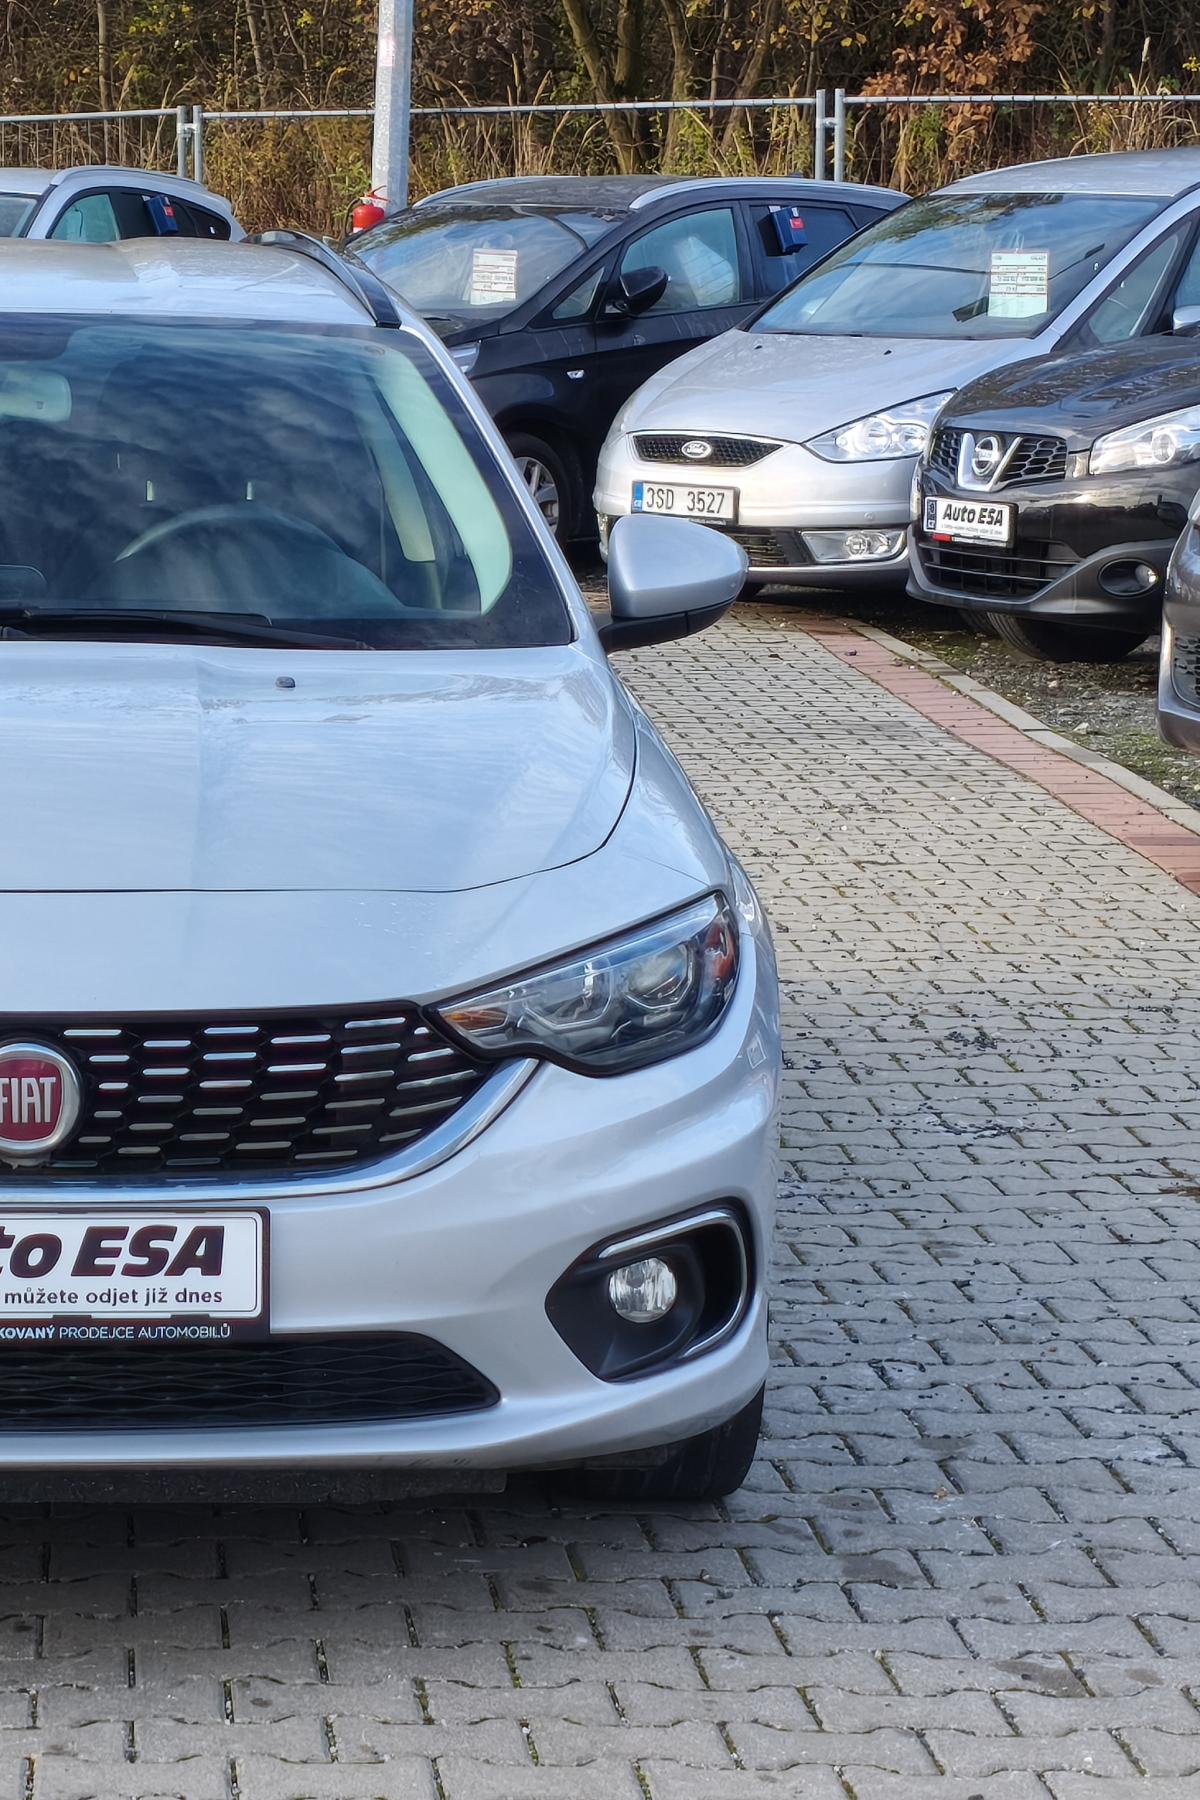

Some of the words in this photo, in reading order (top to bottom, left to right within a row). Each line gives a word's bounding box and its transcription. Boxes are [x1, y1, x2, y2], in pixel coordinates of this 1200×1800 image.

[646, 487, 674, 510] 3SD
[687, 491, 725, 514] 3527
[942, 503, 976, 523] Auto
[978, 507, 1004, 527] ESA
[71, 1225, 225, 1277] ESA
[4, 1287, 79, 1304] můžete
[86, 1288, 139, 1307] odjet
[144, 1287, 168, 1307] již
[175, 1288, 223, 1304] dnes
[59, 1326, 135, 1340] PRODEJCE
[137, 1322, 231, 1340] AUTOMOBILŮ
